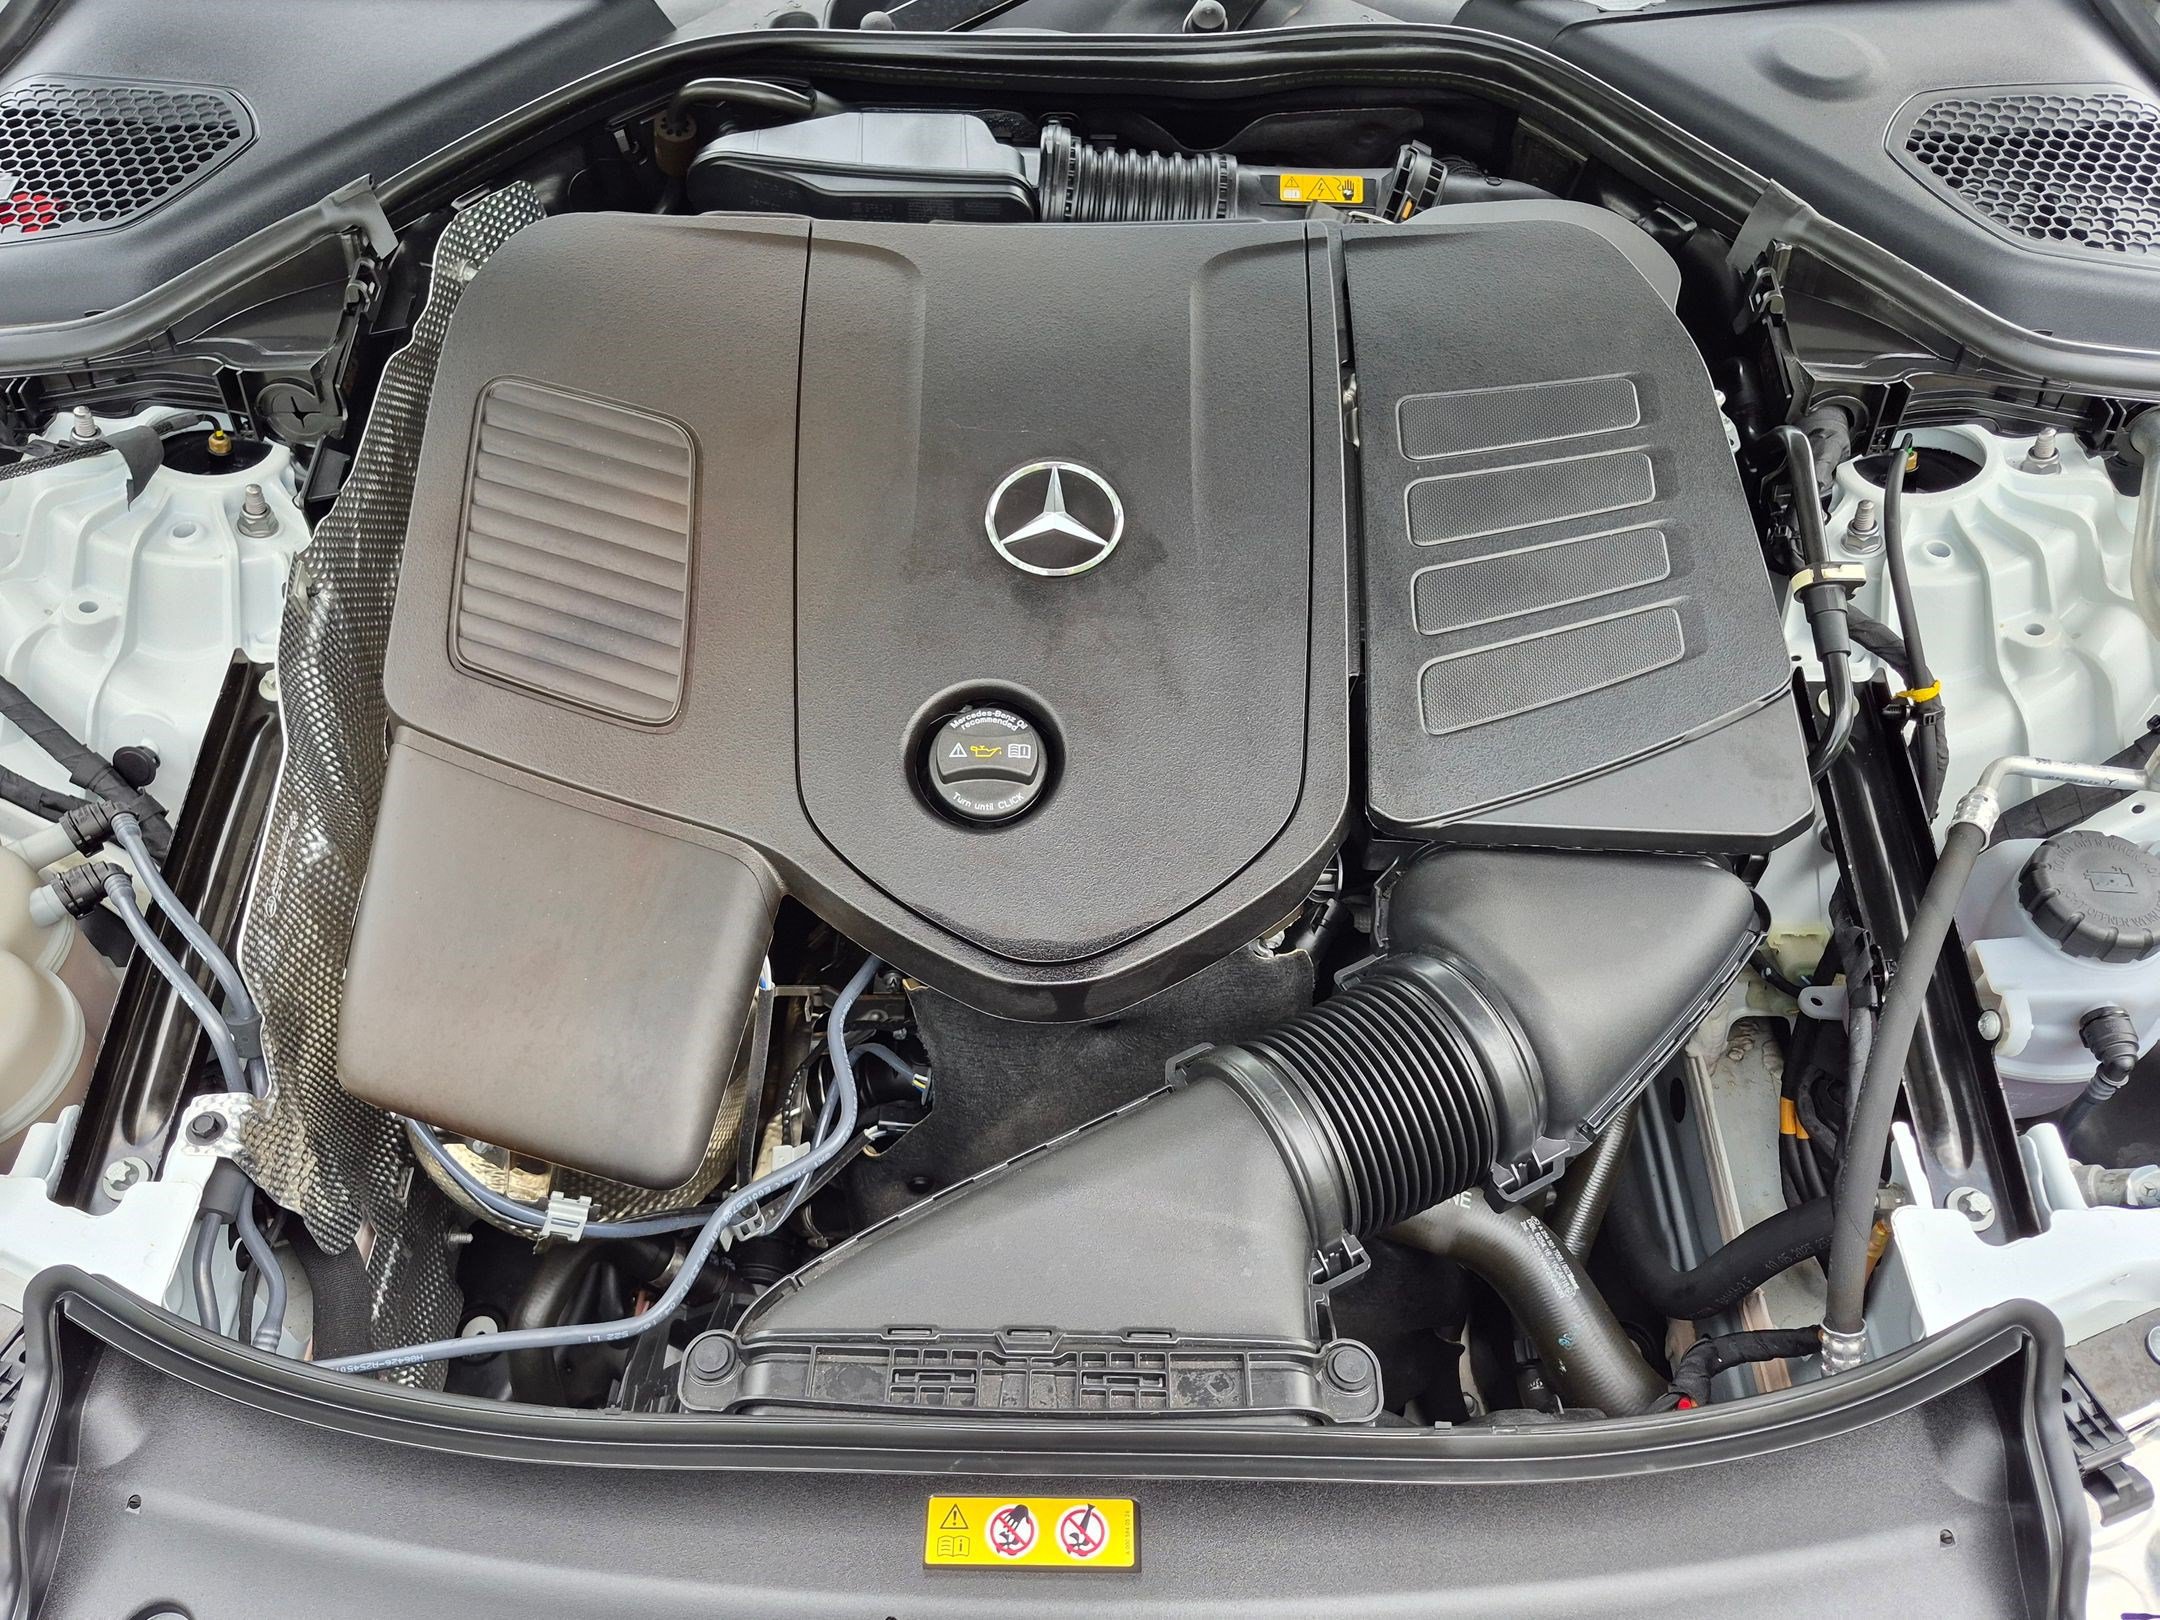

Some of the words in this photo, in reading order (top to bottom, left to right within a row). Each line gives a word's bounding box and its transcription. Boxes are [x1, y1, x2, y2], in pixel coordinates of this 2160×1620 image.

[950, 710, 1017, 729] Mercedes-Benz
[1016, 719, 1028, 730] Oil
[961, 717, 1020, 731] recommended
[953, 792, 972, 807] Turn
[974, 802, 994, 811] until
[997, 792, 1024, 809] CLICK
